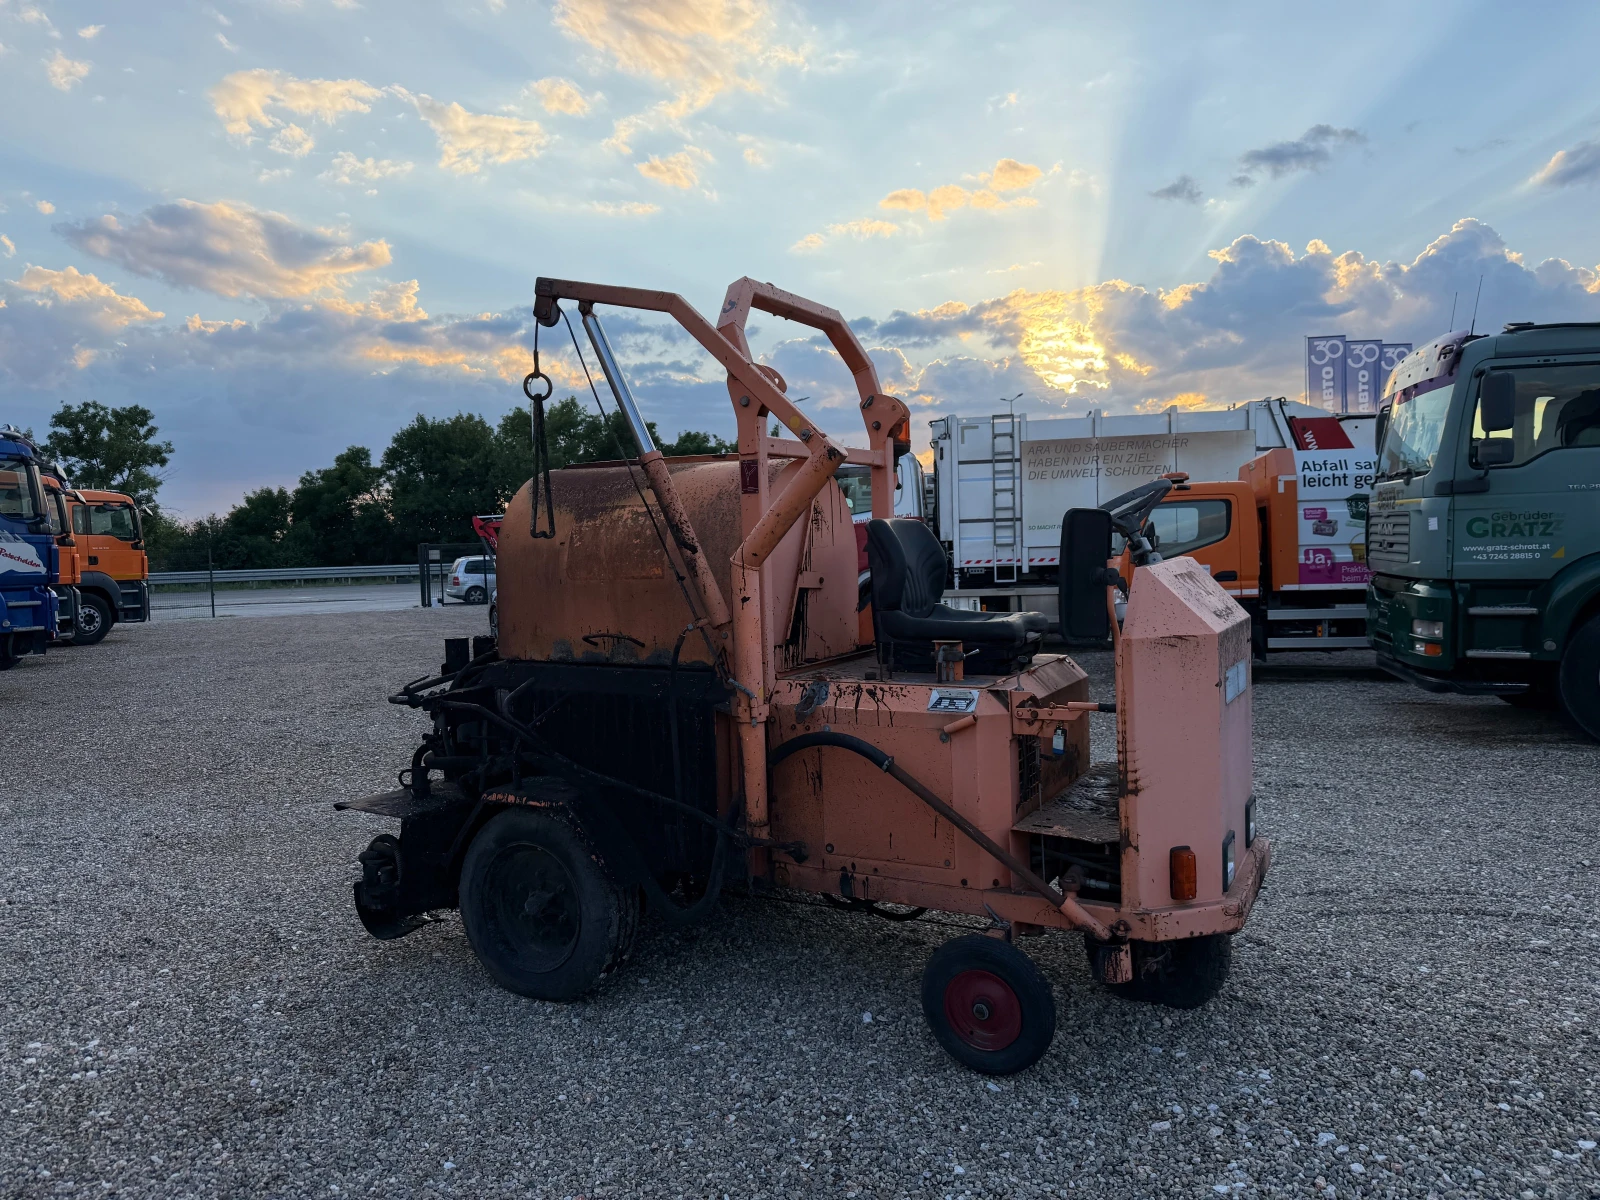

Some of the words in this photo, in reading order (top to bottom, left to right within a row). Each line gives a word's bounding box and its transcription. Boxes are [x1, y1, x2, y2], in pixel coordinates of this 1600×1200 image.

[1311, 340, 1344, 365] 30
[1348, 344, 1380, 368] 30
[1027, 446, 1051, 455] ARA
[1054, 443, 1082, 454] UND
[1084, 438, 1189, 452] SAUBERMACHER
[1028, 456, 1071, 468] HABEN
[1073, 455, 1099, 466] NUR
[1103, 454, 1123, 465] EIN
[1126, 453, 1156, 464] ZIEL:
[1301, 459, 1348, 472] Abfall
[1028, 470, 1048, 481] DIE
[1051, 467, 1102, 479] UMWELT
[1303, 473, 1348, 488] leicht
[1491, 510, 1554, 521] Gebrüder
[1466, 516, 1555, 538] GRATZ
[1462, 543, 1551, 552] www.gratz-schrott.at
[1305, 549, 1331, 566] Ja,
[1342, 574, 1361, 582] beim
